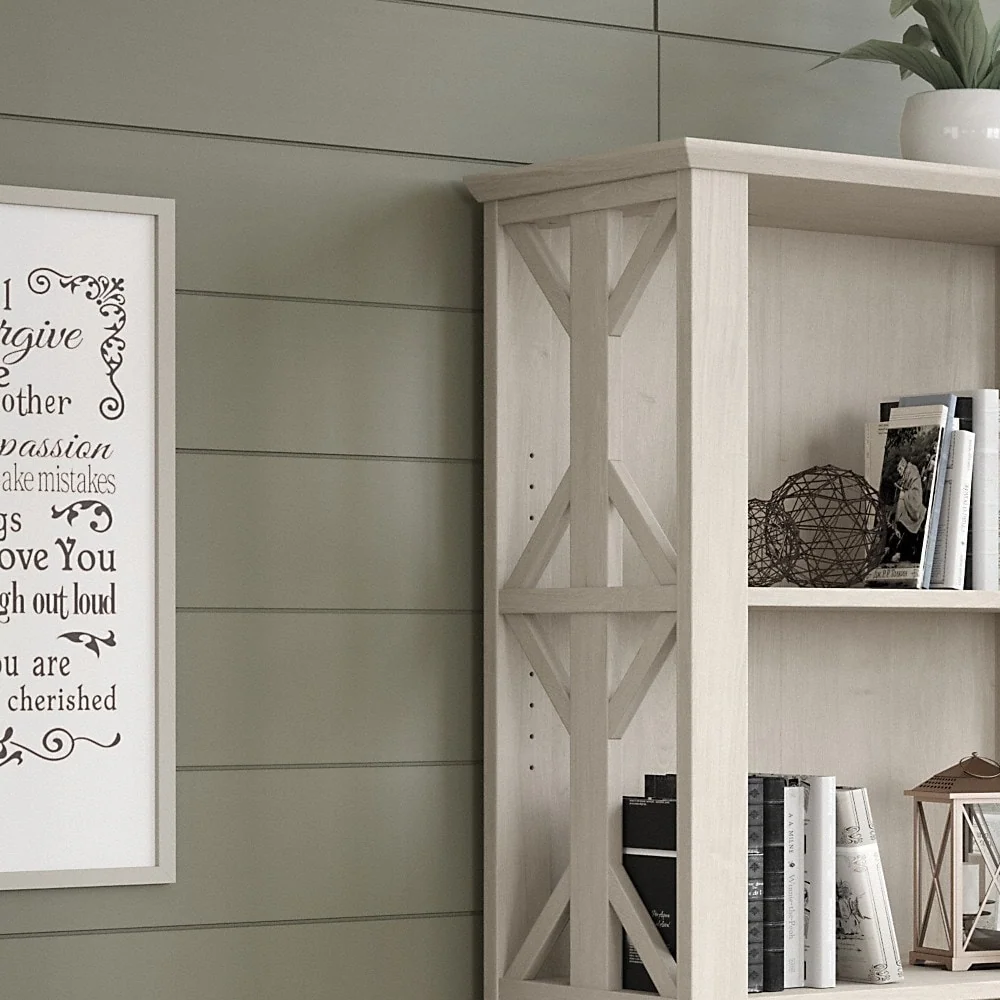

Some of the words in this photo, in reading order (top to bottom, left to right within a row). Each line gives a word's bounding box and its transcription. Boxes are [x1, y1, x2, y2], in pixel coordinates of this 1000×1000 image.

[2, 384, 71, 416] other
[2, 462, 34, 492] ake
[38, 464, 116, 494] mistakes
[54, 536, 116, 572] You
[33, 585, 69, 620] out
[73, 582, 116, 615] loud
[0, 656, 19, 677] u
[32, 656, 71, 677] are
[8, 684, 117, 712] cherished
